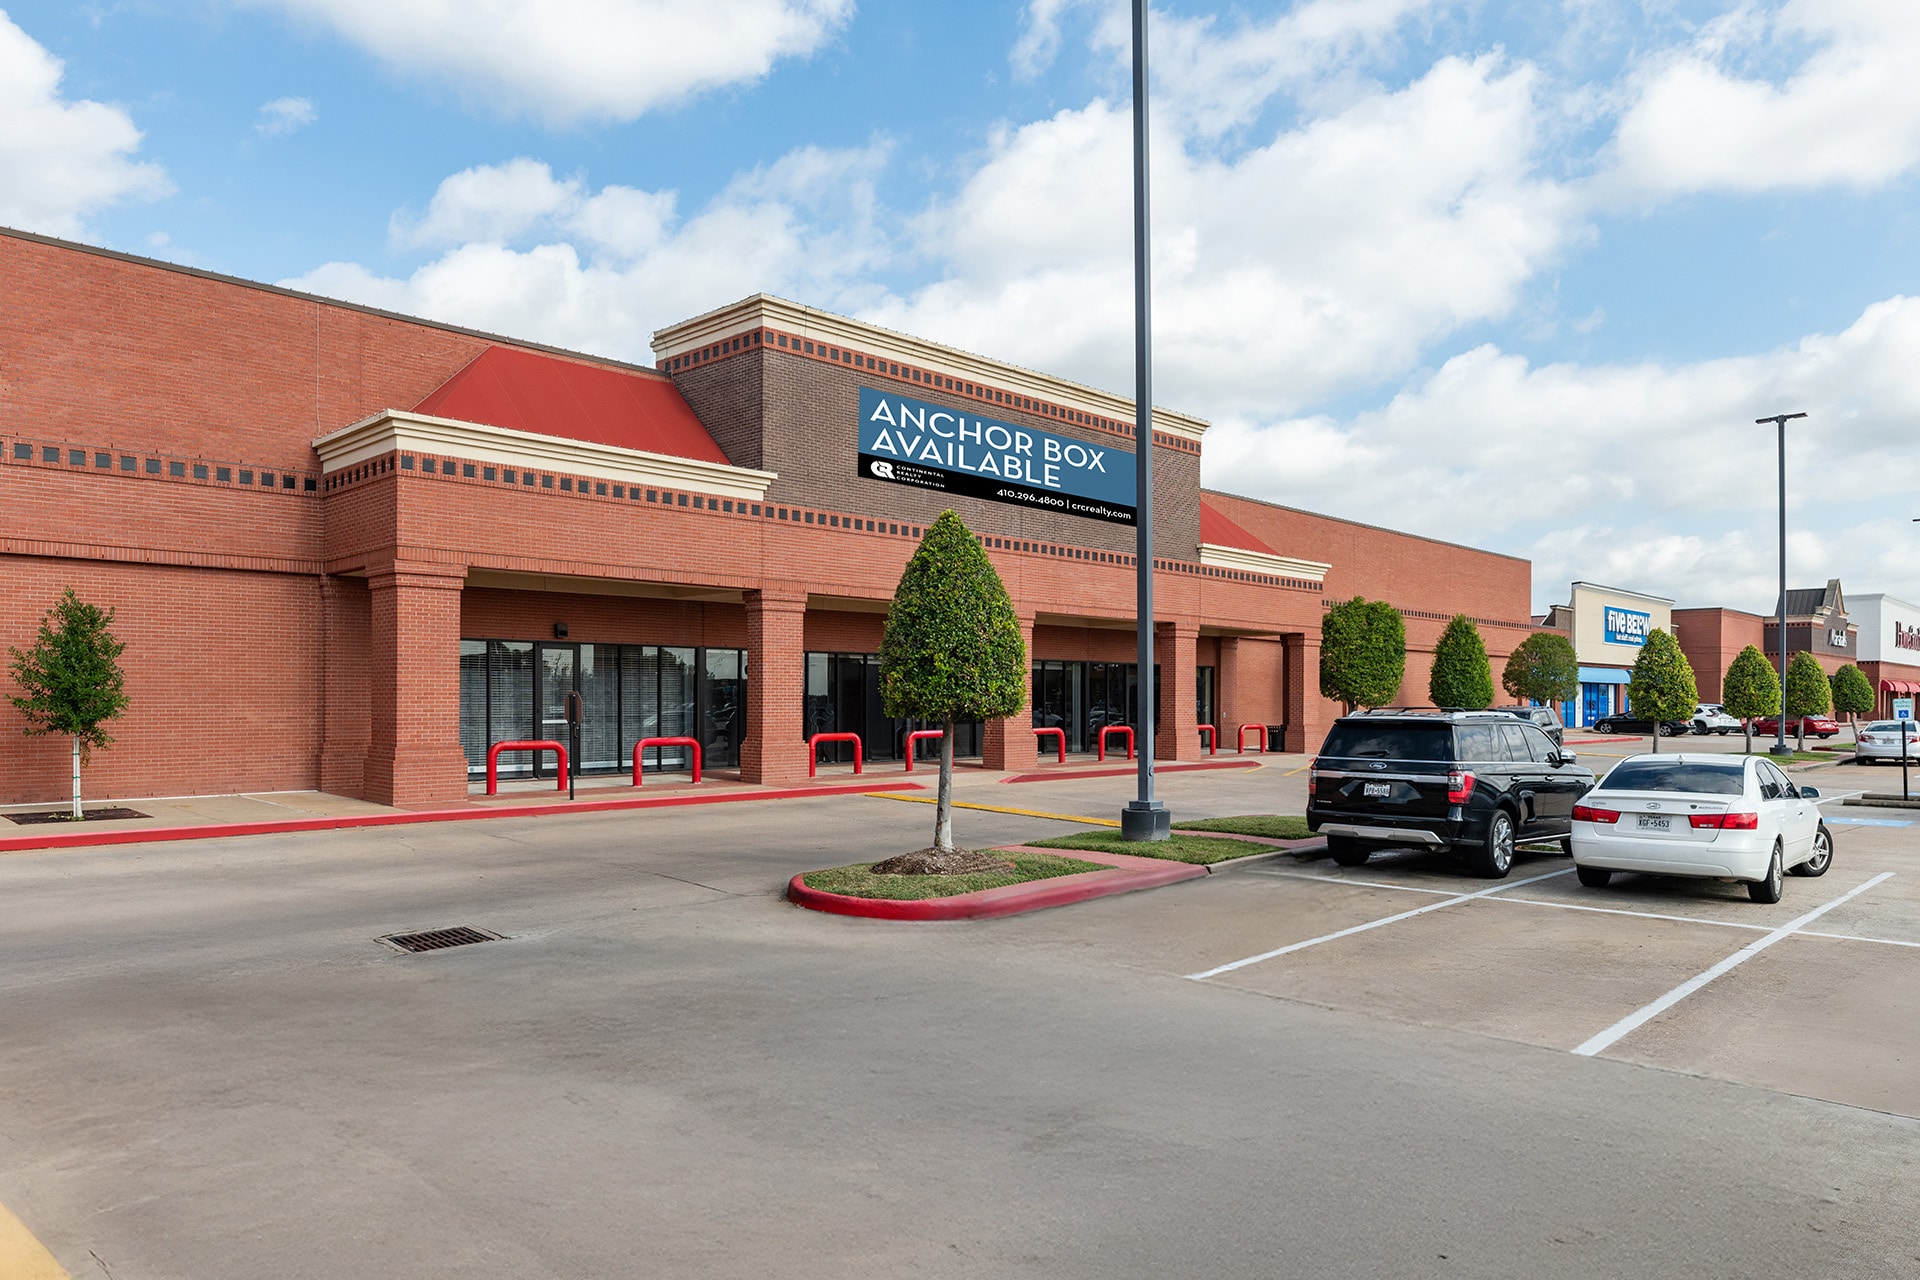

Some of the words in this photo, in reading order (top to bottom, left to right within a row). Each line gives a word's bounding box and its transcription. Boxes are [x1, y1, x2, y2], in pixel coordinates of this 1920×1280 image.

[870, 398, 1033, 457] ANCHOR
[1044, 438, 1106, 473] BOX
[870, 428, 1061, 488] AVAILABLE
[896, 465, 945, 478] CONTINENTAL
[896, 470, 922, 479] REALTY
[896, 475, 945, 488] CORPORATION
[996, 489, 1064, 507] 410.296.4800
[1071, 502, 1131, 519] crcrealty.com
